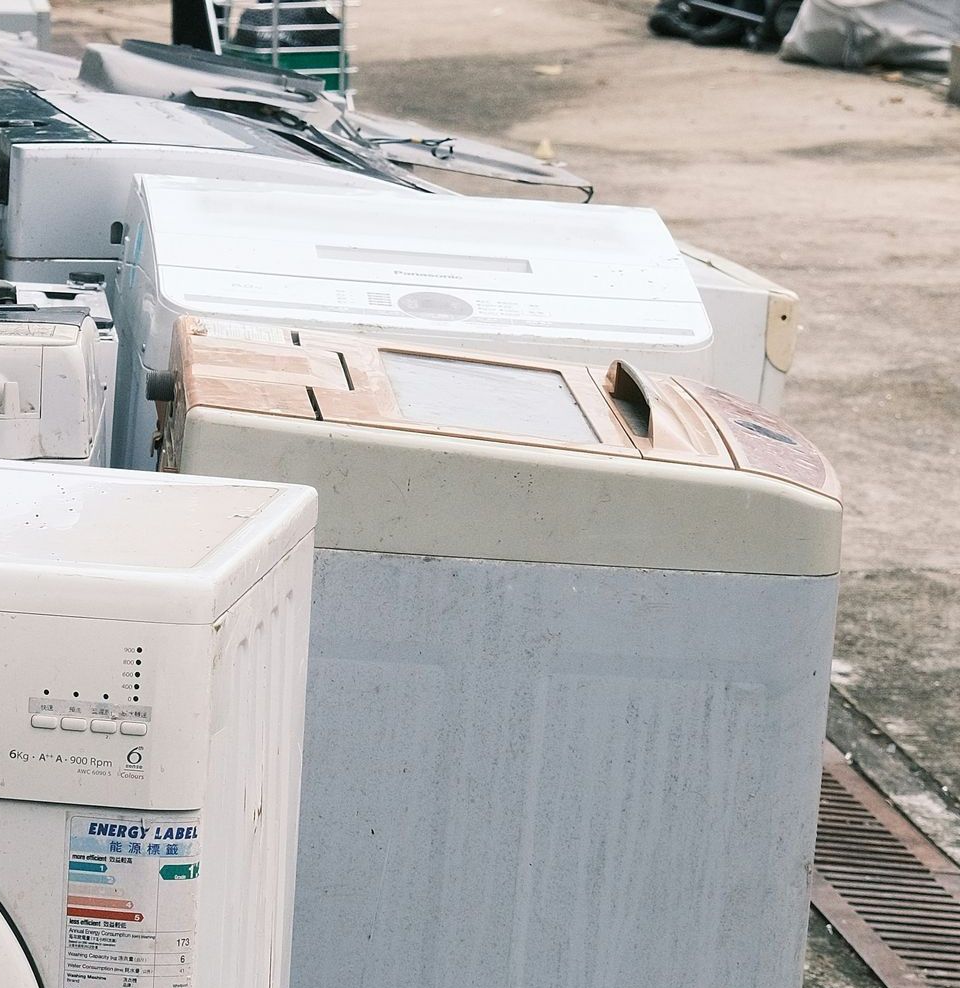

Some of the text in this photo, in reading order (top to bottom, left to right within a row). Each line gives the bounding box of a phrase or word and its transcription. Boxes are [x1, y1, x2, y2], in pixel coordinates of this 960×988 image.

[393, 270, 463, 280] Panasonic
[9, 749, 29, 762] 6Kg
[55, 754, 63, 763] A
[69, 755, 88, 766] 900
[90, 757, 113, 768] Rpm
[120, 771, 144, 780] Colours
[88, 822, 198, 840] ENERGY LABEL
[109, 841, 179, 856] 能源標籤
[86, 854, 107, 862] efficient
[80, 919, 101, 927] efficient
[85, 928, 100, 936] Energy
[101, 930, 131, 938] Consumption
[176, 938, 190, 947] 173
[180, 955, 186, 963] 6
[82, 963, 114, 971] Consumption
